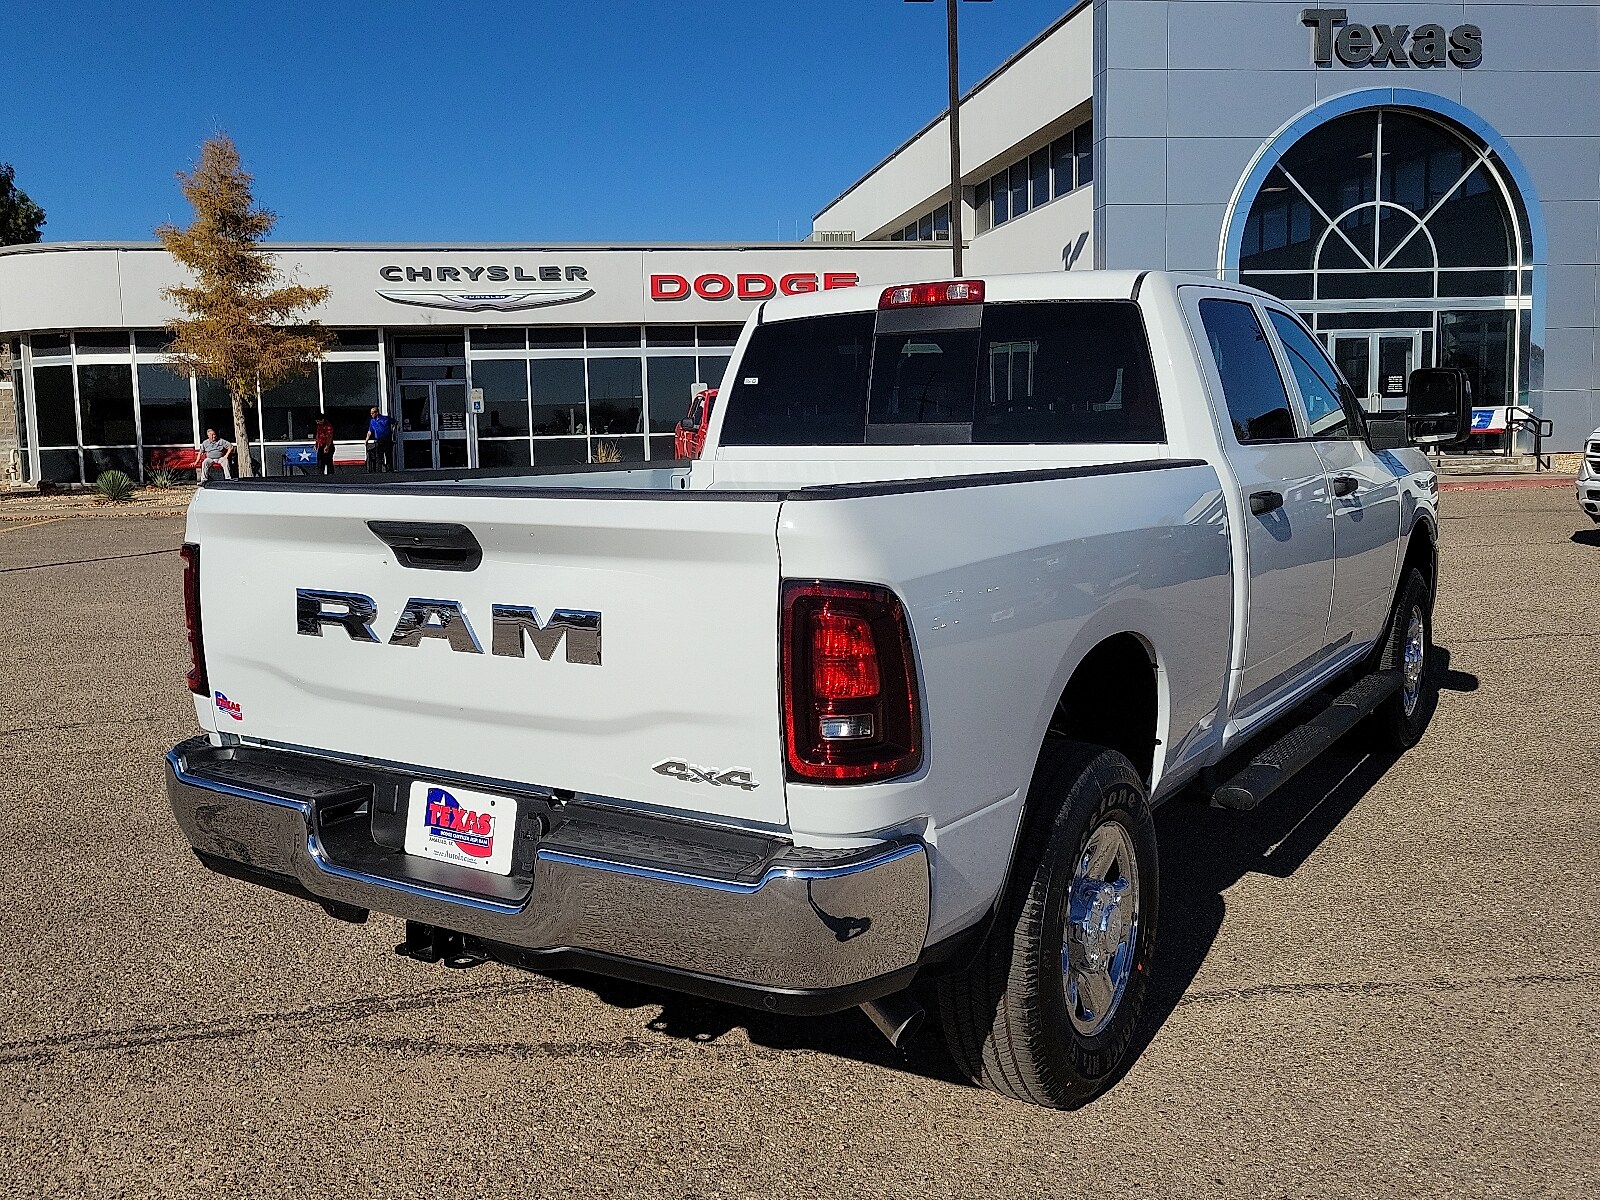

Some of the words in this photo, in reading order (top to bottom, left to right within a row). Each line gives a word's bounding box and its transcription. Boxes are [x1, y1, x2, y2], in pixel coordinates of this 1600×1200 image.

[1301, 9, 1483, 69] Texas
[379, 265, 589, 282] CHRYSLER
[650, 273, 860, 302] DODGE
[296, 588, 602, 666] RAM
[429, 803, 491, 835] TEXAS
